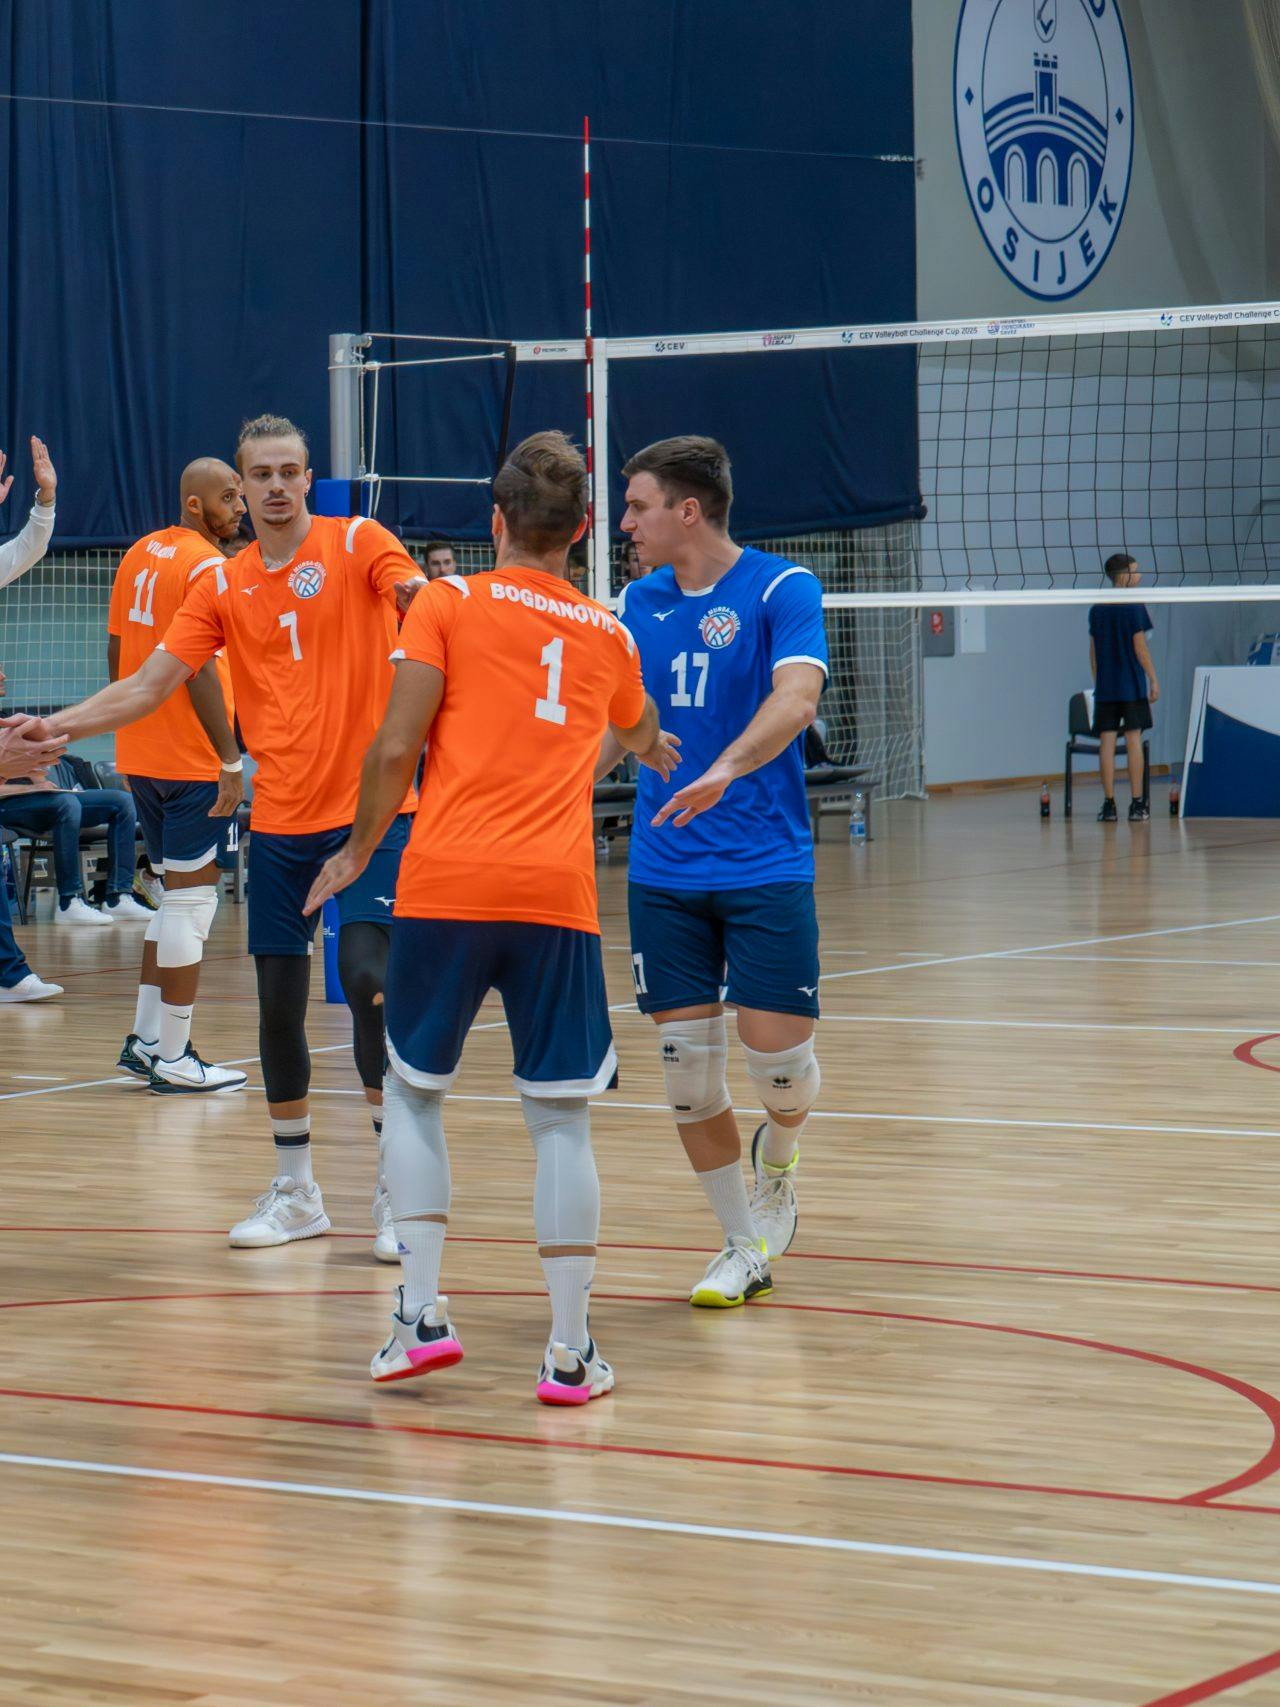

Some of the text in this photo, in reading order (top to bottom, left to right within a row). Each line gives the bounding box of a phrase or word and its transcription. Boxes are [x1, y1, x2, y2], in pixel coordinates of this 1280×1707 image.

[977, 177, 1117, 285] OSIJEK
[859, 331, 874, 340] CEV
[874, 329, 909, 340] Volleyball
[909, 328, 944, 337] Challenge
[945, 327, 960, 336] Cup
[1197, 312, 1233, 322] Volleyball
[1234, 310, 1272, 320] Challenge
[667, 342, 685, 350] CEV
[128, 567, 159, 627] 11
[278, 610, 303, 661] 7
[534, 636, 567, 725] 1
[670, 651, 710, 708] 17
